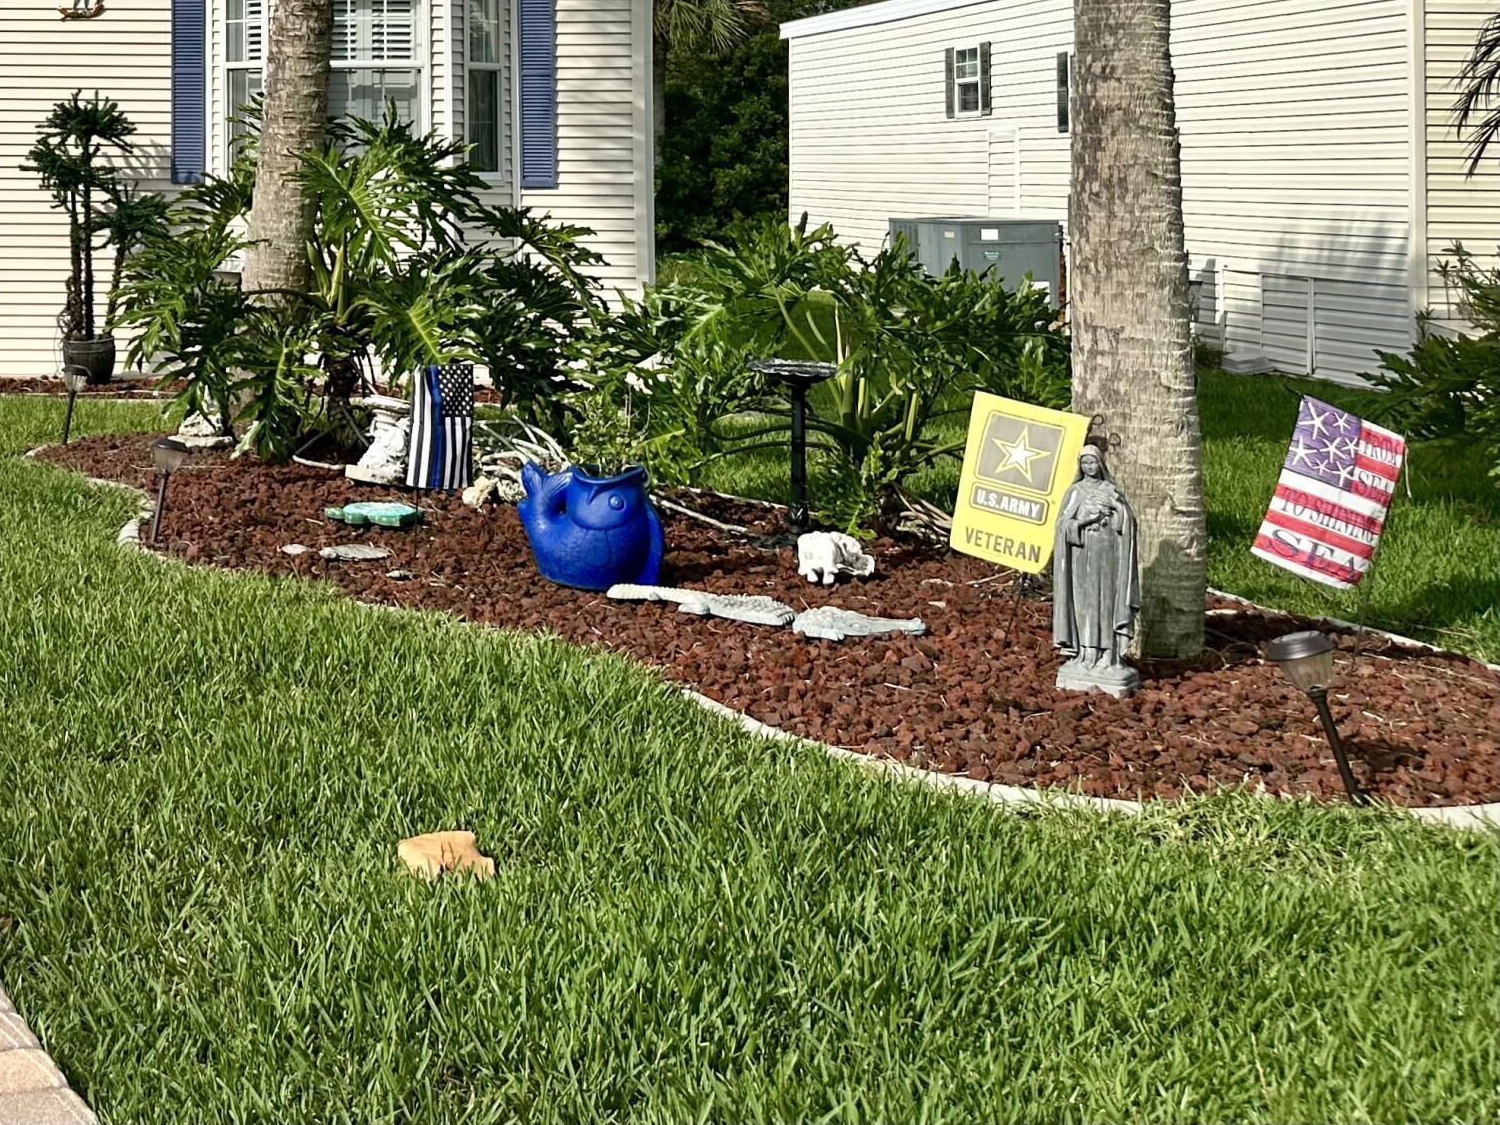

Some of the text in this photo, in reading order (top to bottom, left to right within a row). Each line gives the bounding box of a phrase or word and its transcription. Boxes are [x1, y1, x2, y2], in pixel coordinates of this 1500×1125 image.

[1280, 486, 1309, 517] TO
[965, 526, 1042, 564] VETERAN
[1269, 528, 1364, 584] SEA
